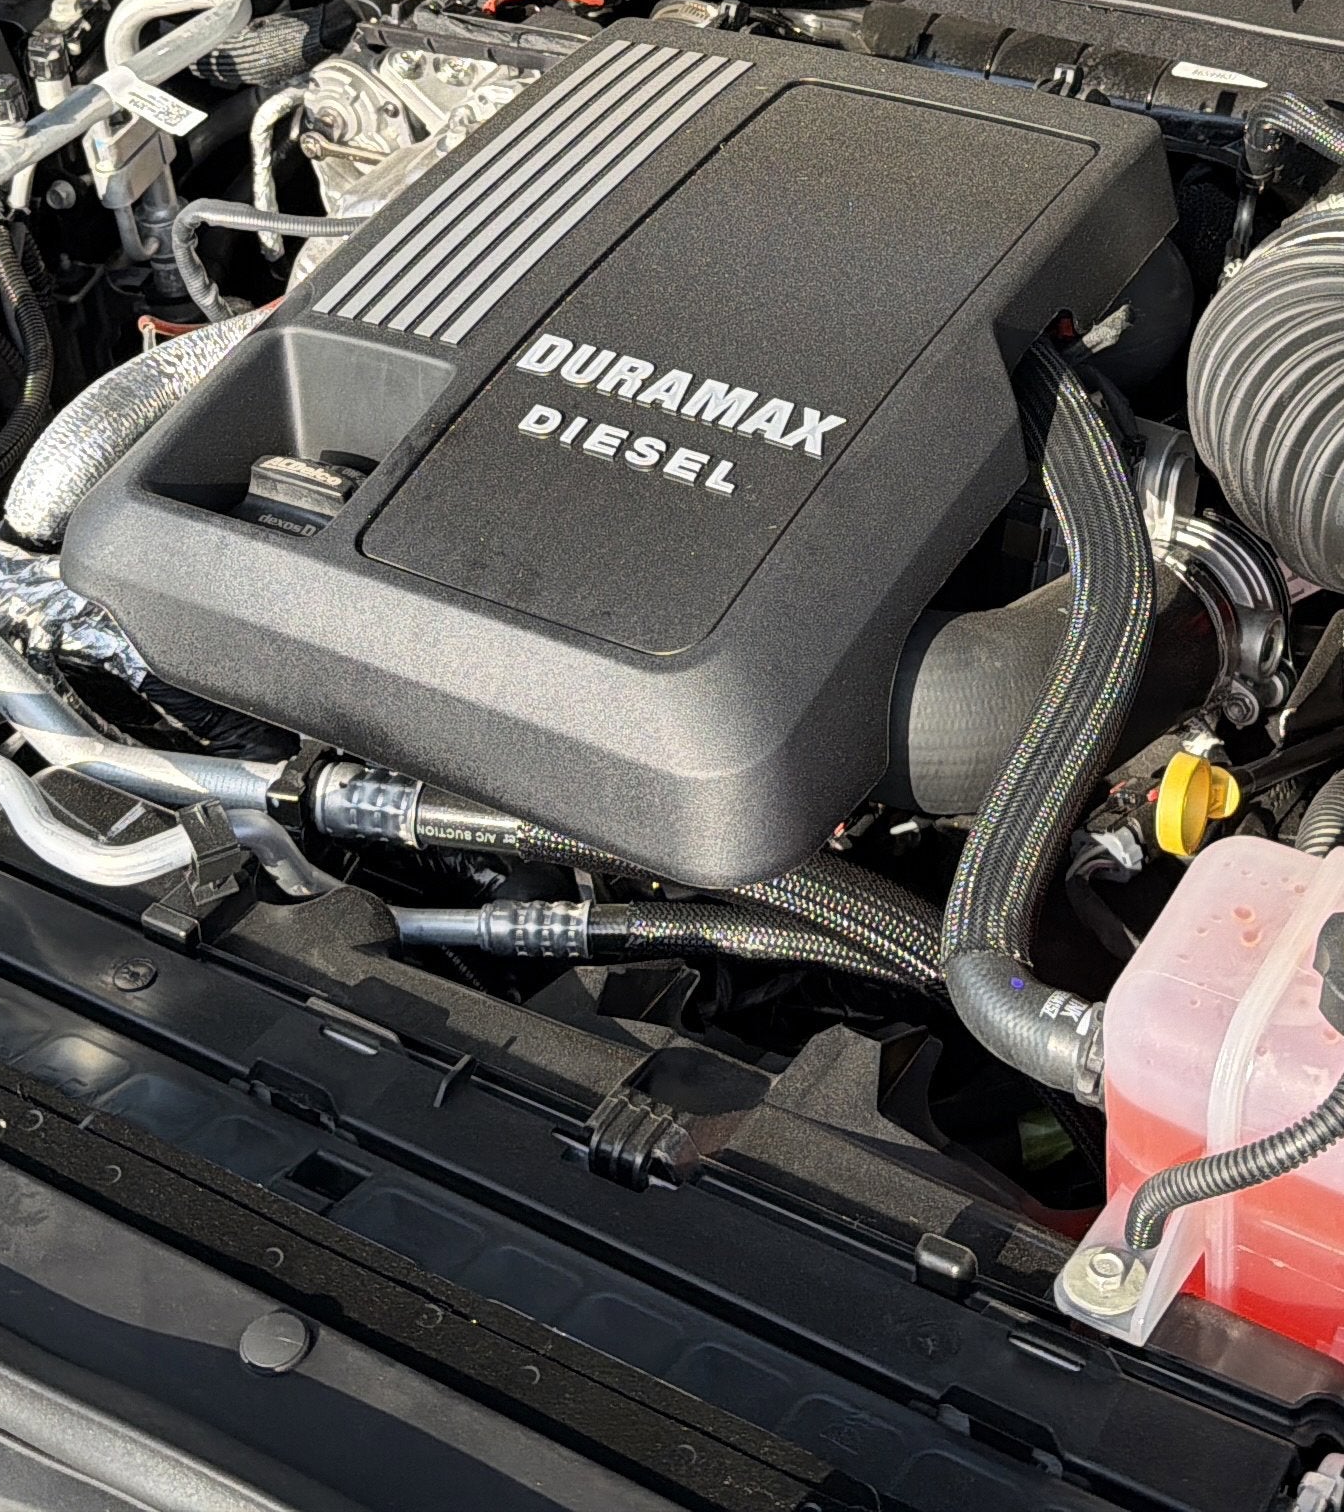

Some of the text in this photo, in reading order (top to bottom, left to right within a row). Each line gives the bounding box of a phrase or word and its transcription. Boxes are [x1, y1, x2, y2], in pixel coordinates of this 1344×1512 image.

[515, 332, 848, 461] DURAMAX
[517, 403, 737, 497] DIESEL
[416, 823, 474, 842] SUCTION
